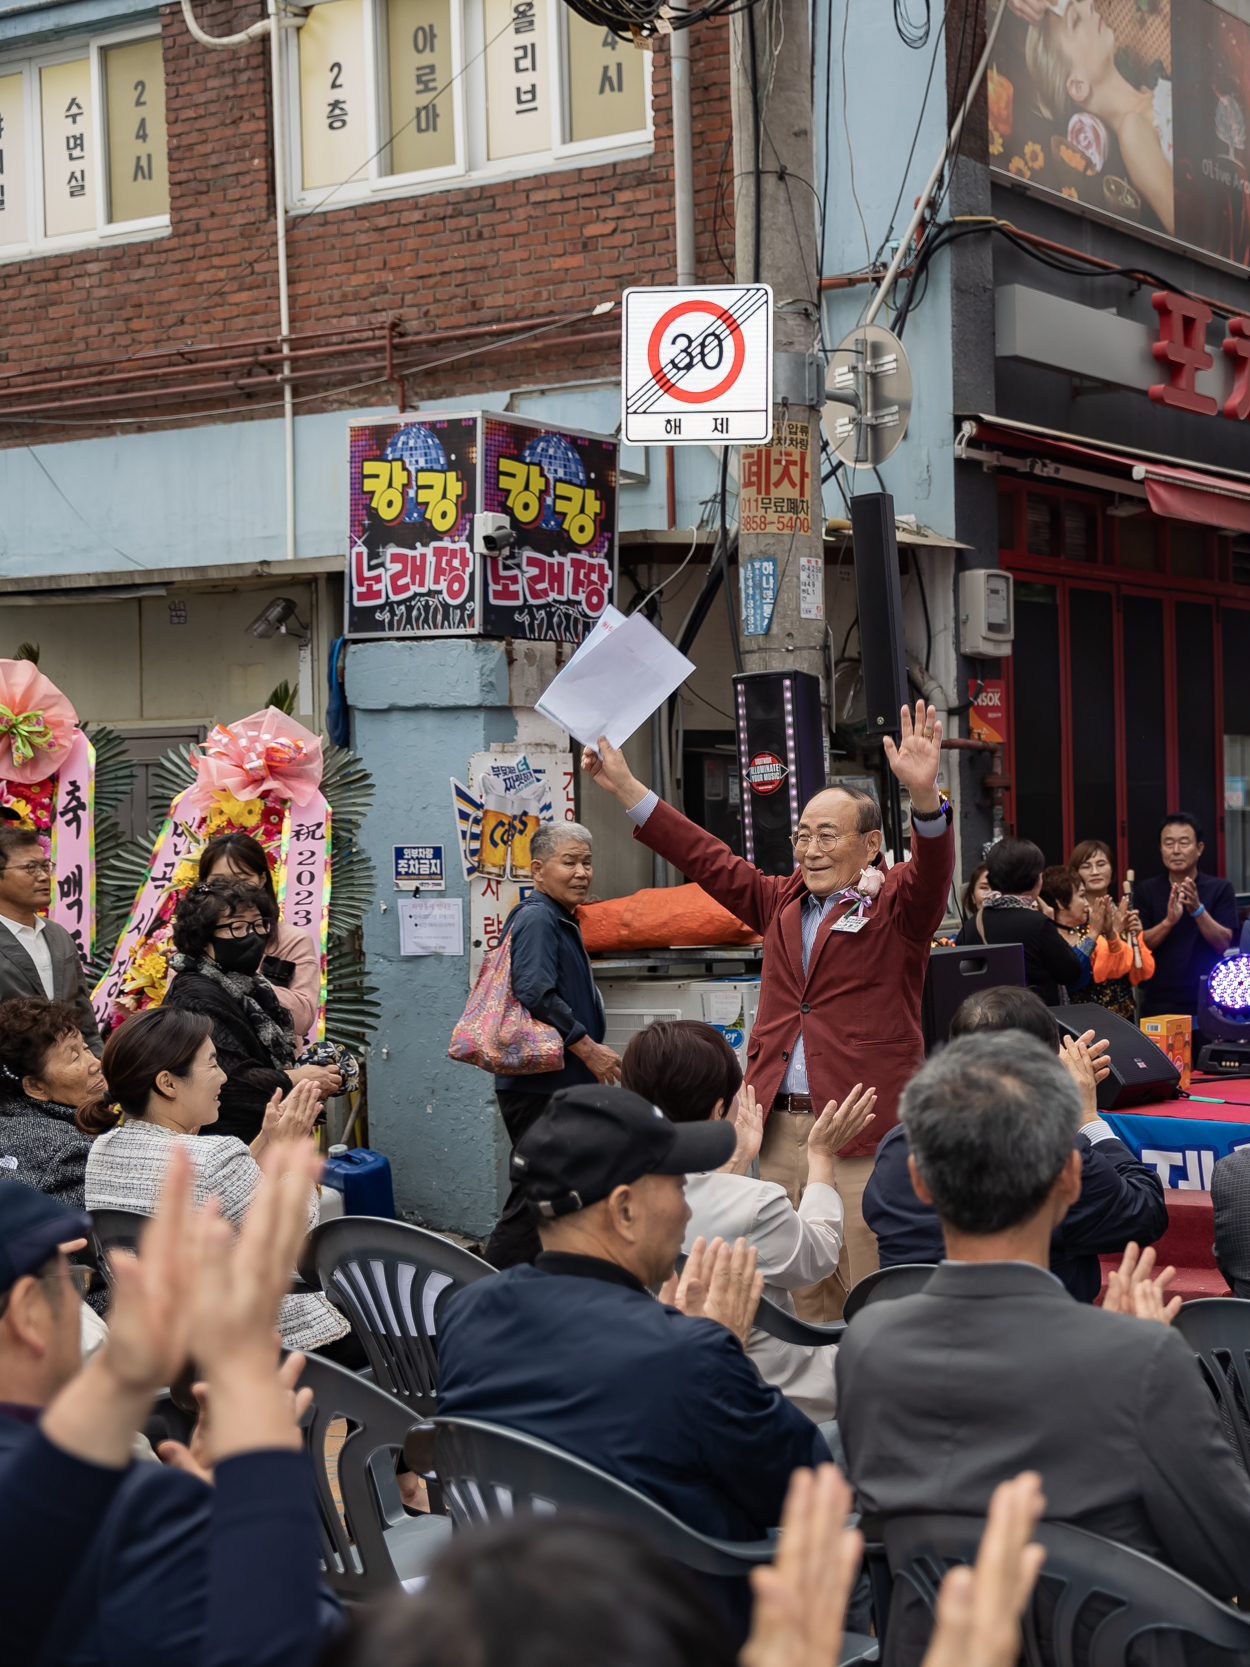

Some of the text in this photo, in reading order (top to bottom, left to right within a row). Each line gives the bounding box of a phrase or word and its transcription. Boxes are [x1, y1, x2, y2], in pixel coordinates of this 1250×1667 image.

[412, 24, 440, 134] 아로마
[513, 1, 538, 115] 올리브
[326, 62, 348, 131] 2층
[65, 96, 86, 198] 수면실
[133, 80, 153, 182] 24시
[669, 333, 724, 371] 30
[742, 448, 809, 499] 폐차
[761, 497, 809, 517] 무료폐차
[59, 779, 86, 840] 축
[290, 821, 326, 842] 祝
[398, 859, 440, 875] 주차금지
[403, 848, 434, 859] 외부차량
[293, 850, 317, 927] 2023
